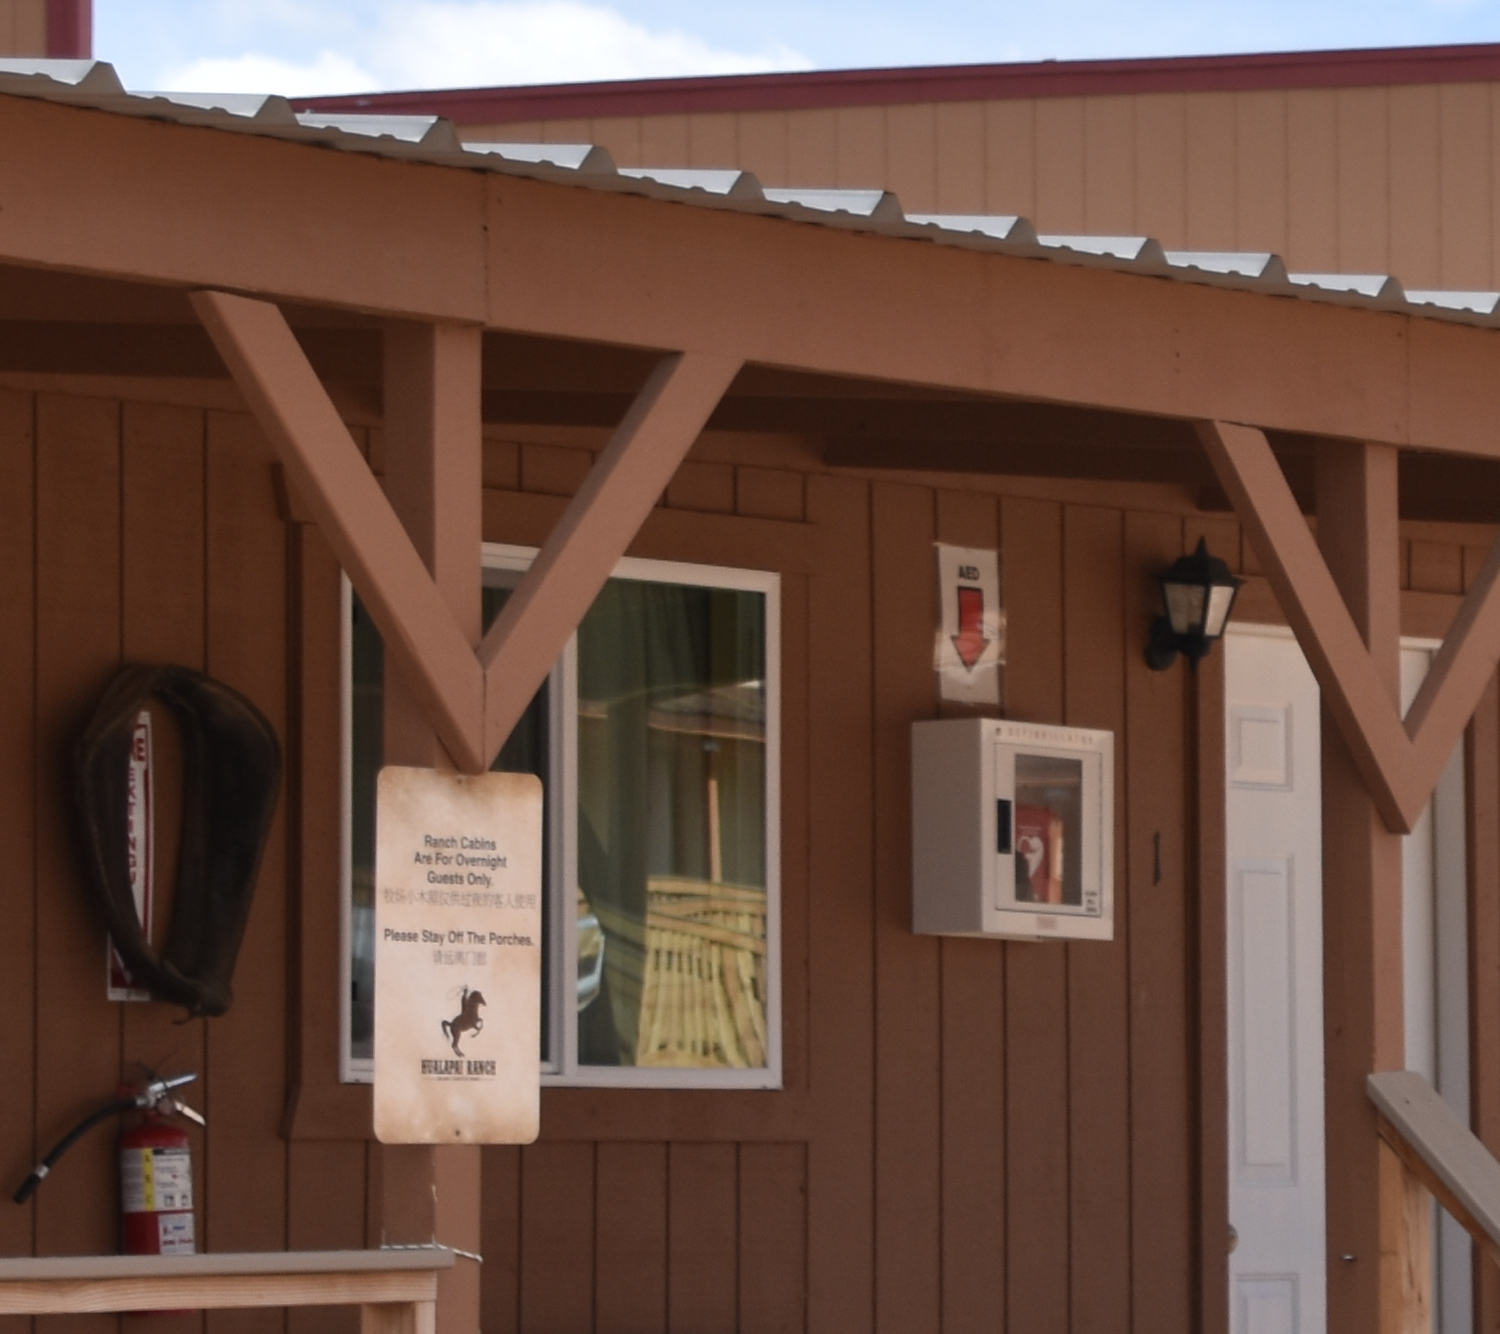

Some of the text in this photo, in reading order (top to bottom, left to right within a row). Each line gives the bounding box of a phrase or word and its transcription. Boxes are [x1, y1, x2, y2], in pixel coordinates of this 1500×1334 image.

[959, 566, 980, 581] AED
[424, 834, 497, 851] Ranch Cabins
[414, 852, 507, 871] Are For Overnight
[427, 871, 493, 888] Guests Only.
[384, 928, 534, 946] Please Stay Off The Porches.
